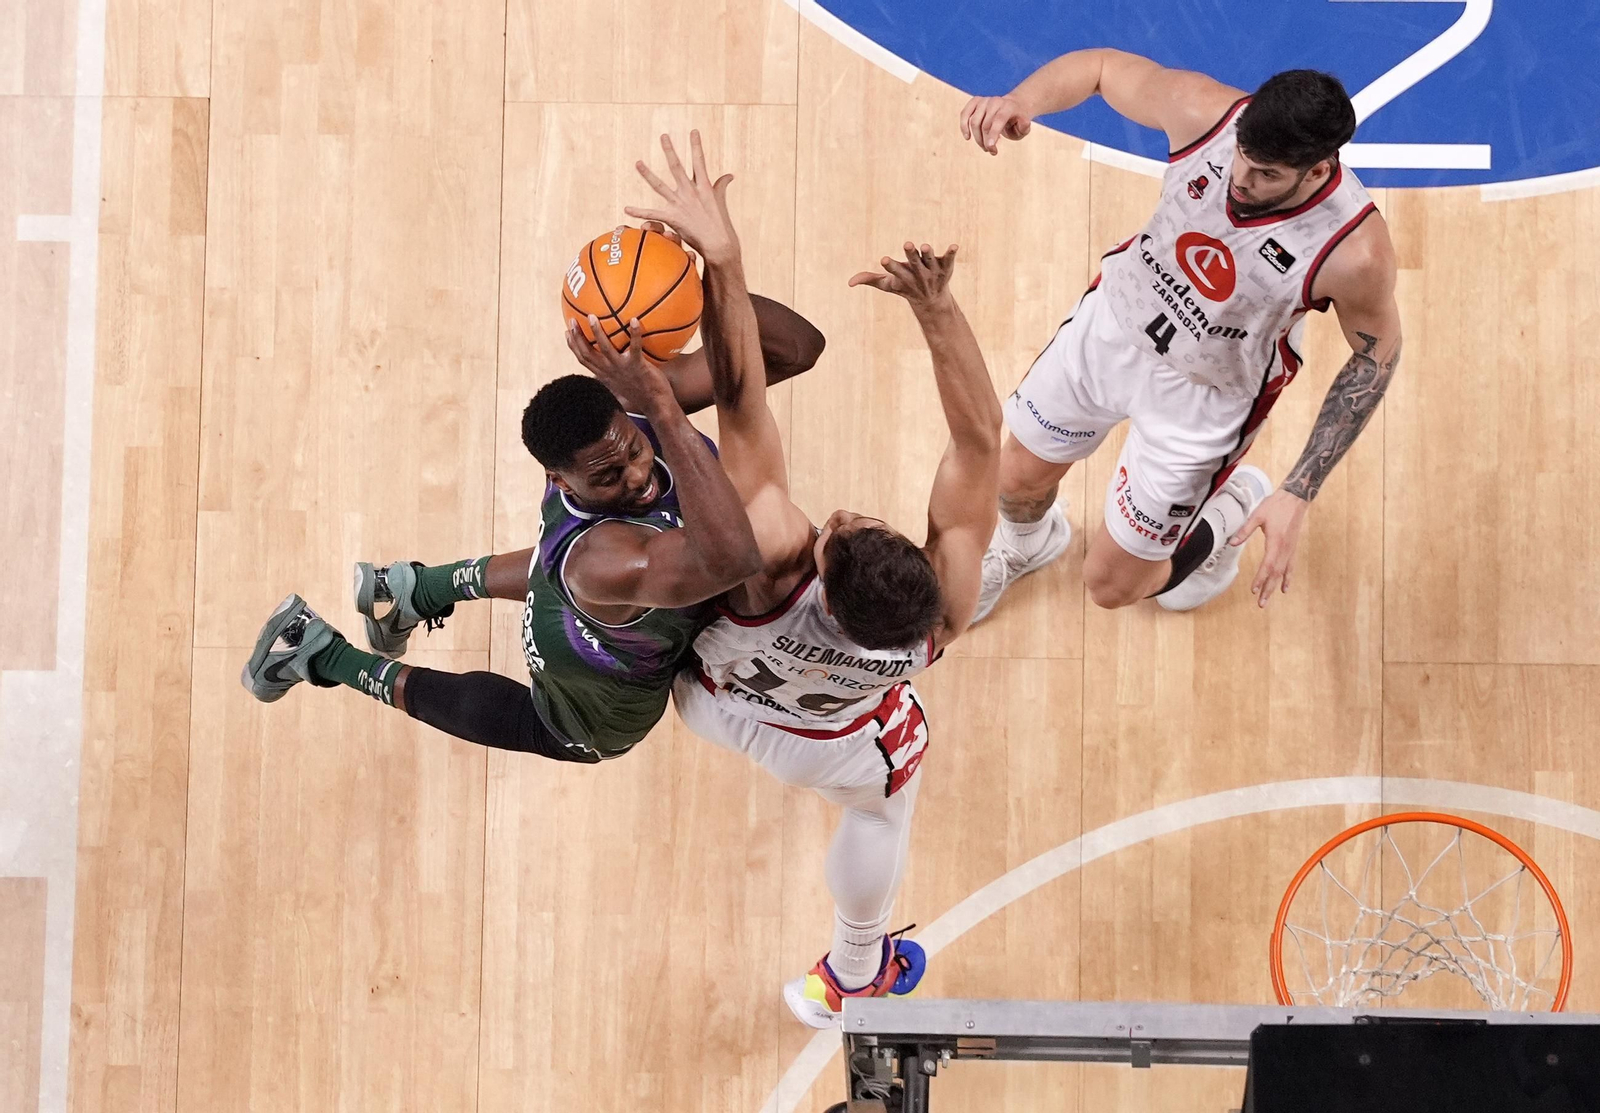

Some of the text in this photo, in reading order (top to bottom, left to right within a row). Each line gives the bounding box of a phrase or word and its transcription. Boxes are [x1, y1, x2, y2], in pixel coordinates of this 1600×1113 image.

[1145, 312, 1177, 356] 4
[1152, 281, 1202, 342] ZARAGOZA
[1117, 496, 1161, 541] DEPORTE
[1125, 486, 1164, 530] Zaragoza
[524, 590, 546, 671] COSTA
